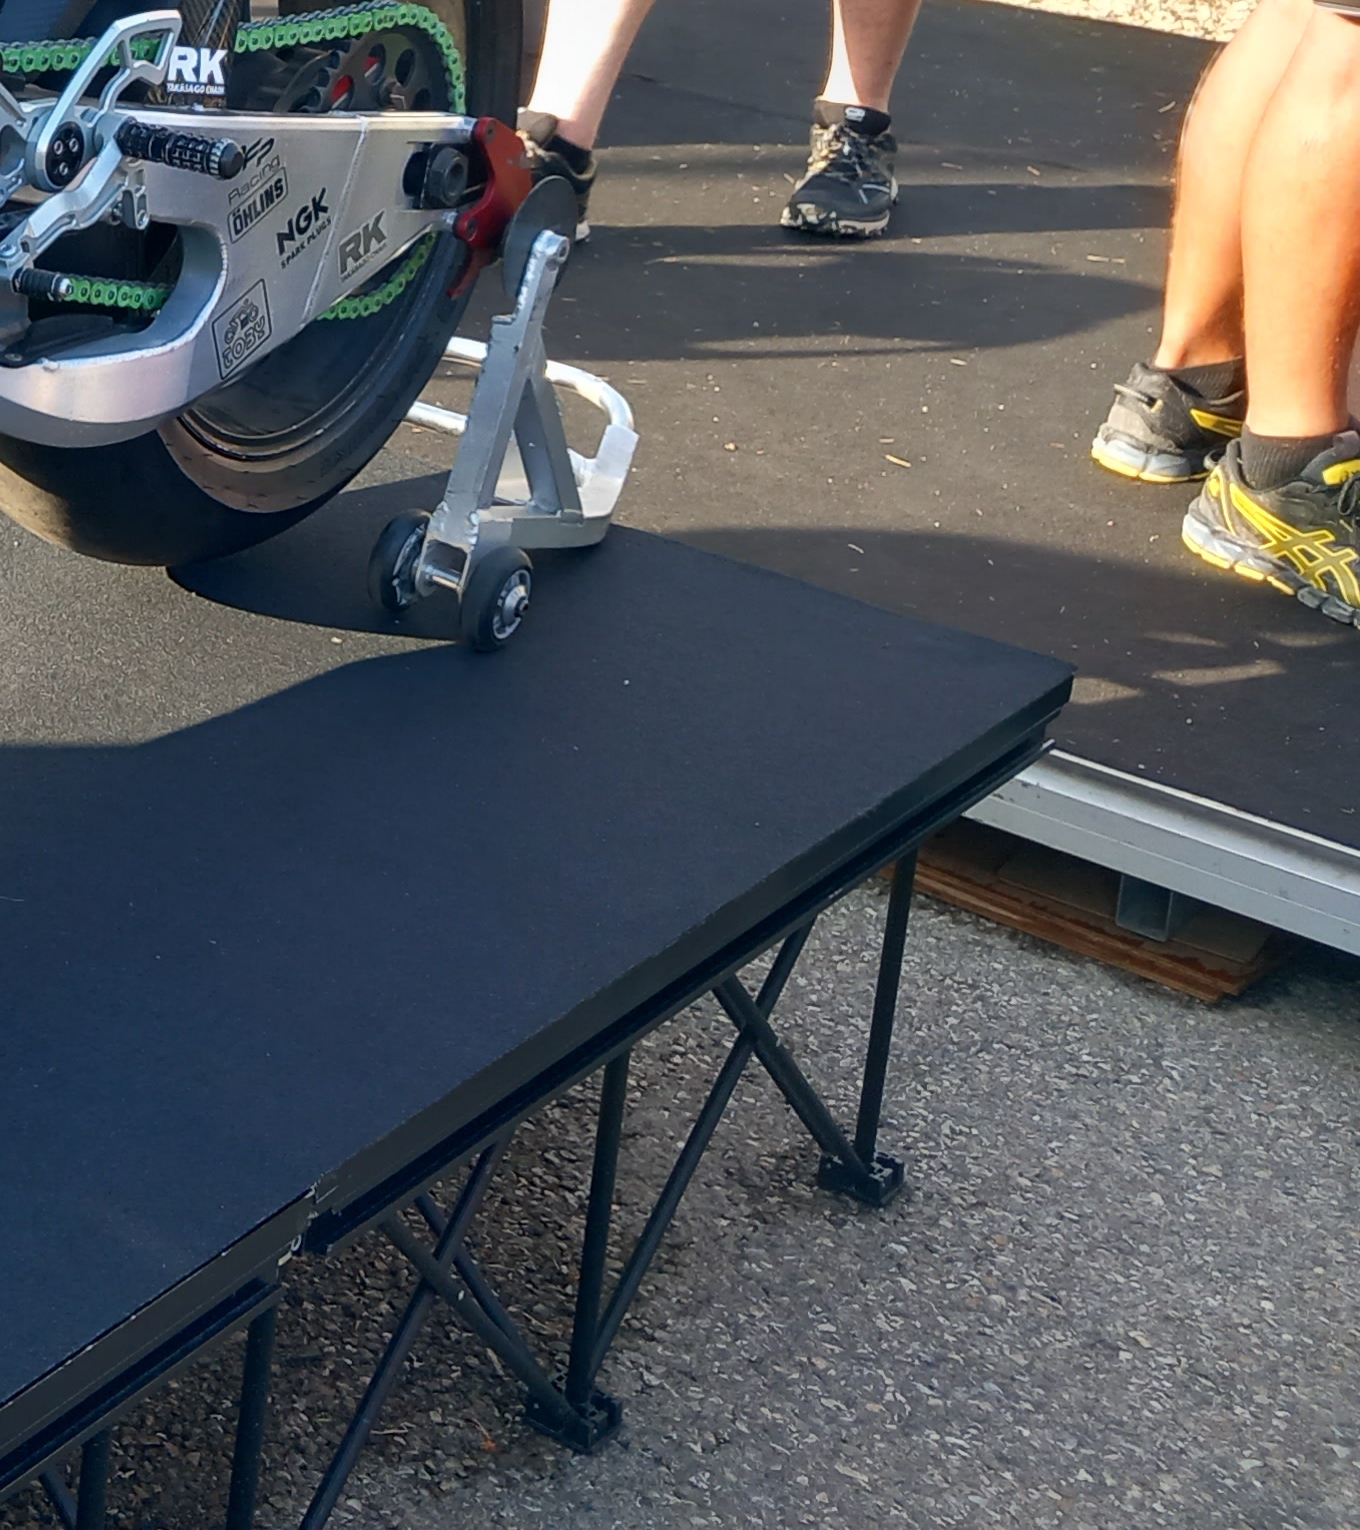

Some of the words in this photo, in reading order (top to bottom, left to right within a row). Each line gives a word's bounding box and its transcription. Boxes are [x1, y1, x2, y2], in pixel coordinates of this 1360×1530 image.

[167, 45, 229, 85] RK
[227, 154, 281, 206] Racing
[232, 177, 285, 237] ÖHLINS
[276, 186, 330, 256] NGK
[339, 209, 387, 275] RK
